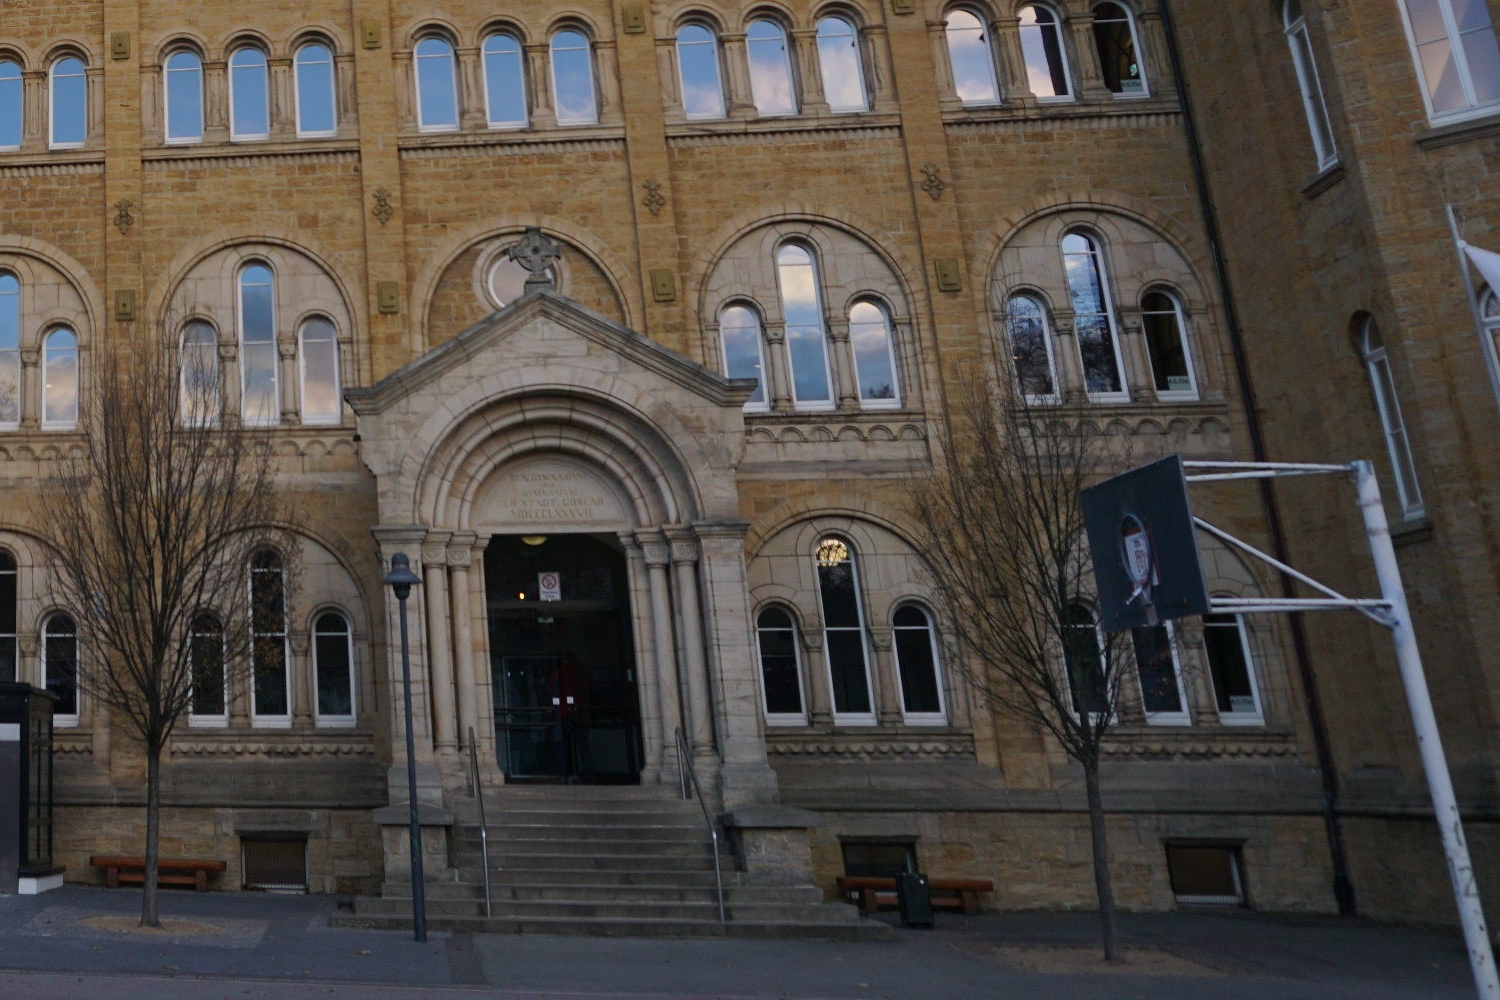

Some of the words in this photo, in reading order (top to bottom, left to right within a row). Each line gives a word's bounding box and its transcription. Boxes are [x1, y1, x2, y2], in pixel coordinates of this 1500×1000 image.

[522, 489, 578, 497] GYMNASIVM
[522, 499, 556, 507] STADT
[562, 497, 604, 507] GOSLAR
